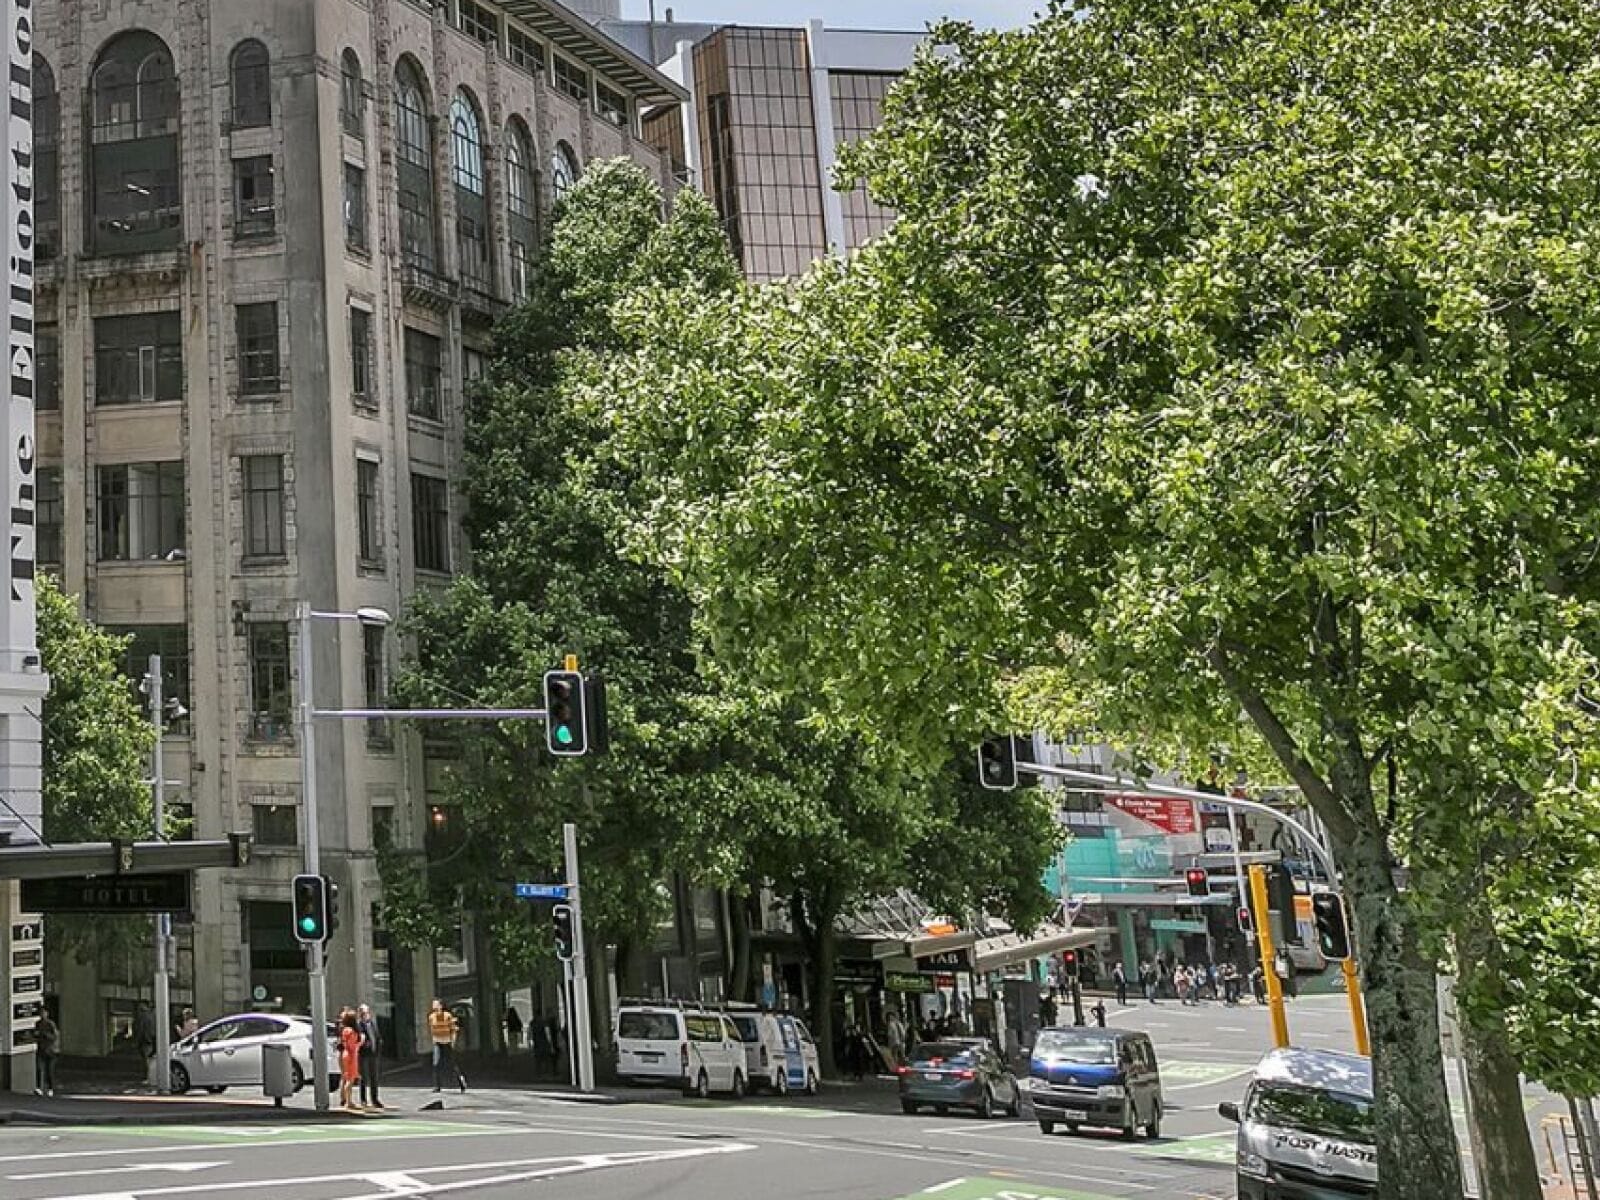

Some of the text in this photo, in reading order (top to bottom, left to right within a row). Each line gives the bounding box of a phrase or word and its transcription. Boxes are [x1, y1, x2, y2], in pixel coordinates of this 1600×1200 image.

[9, 141, 34, 402] Elliott
[10, 433, 35, 603] The
[82, 887, 153, 903] HOTEL
[1274, 1135, 1377, 1163] POST HASTE
